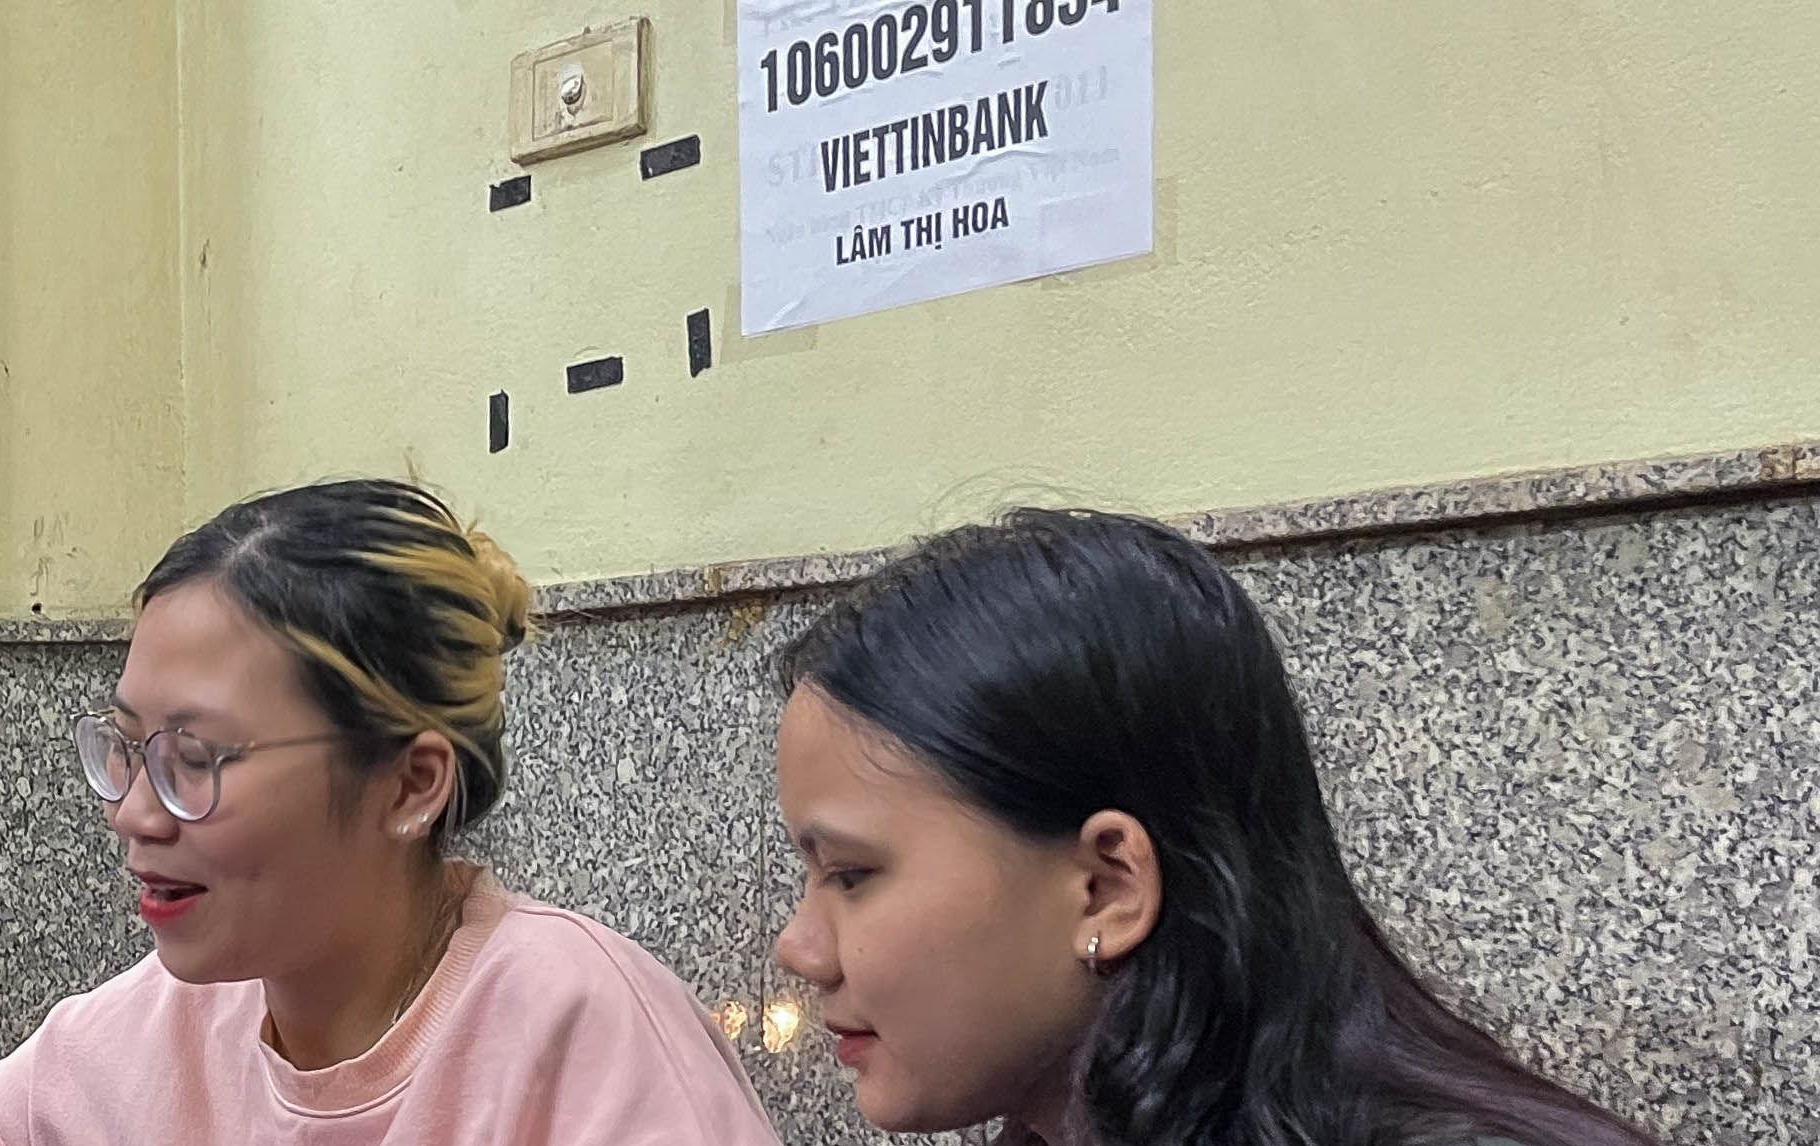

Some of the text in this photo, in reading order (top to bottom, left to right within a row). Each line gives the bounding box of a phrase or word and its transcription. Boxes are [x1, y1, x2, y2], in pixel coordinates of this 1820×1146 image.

[821, 81, 1050, 192] VIETTINBANK
[835, 224, 891, 265] LÂM
[900, 211, 943, 250] THỊ
[952, 197, 1009, 238] HOA
